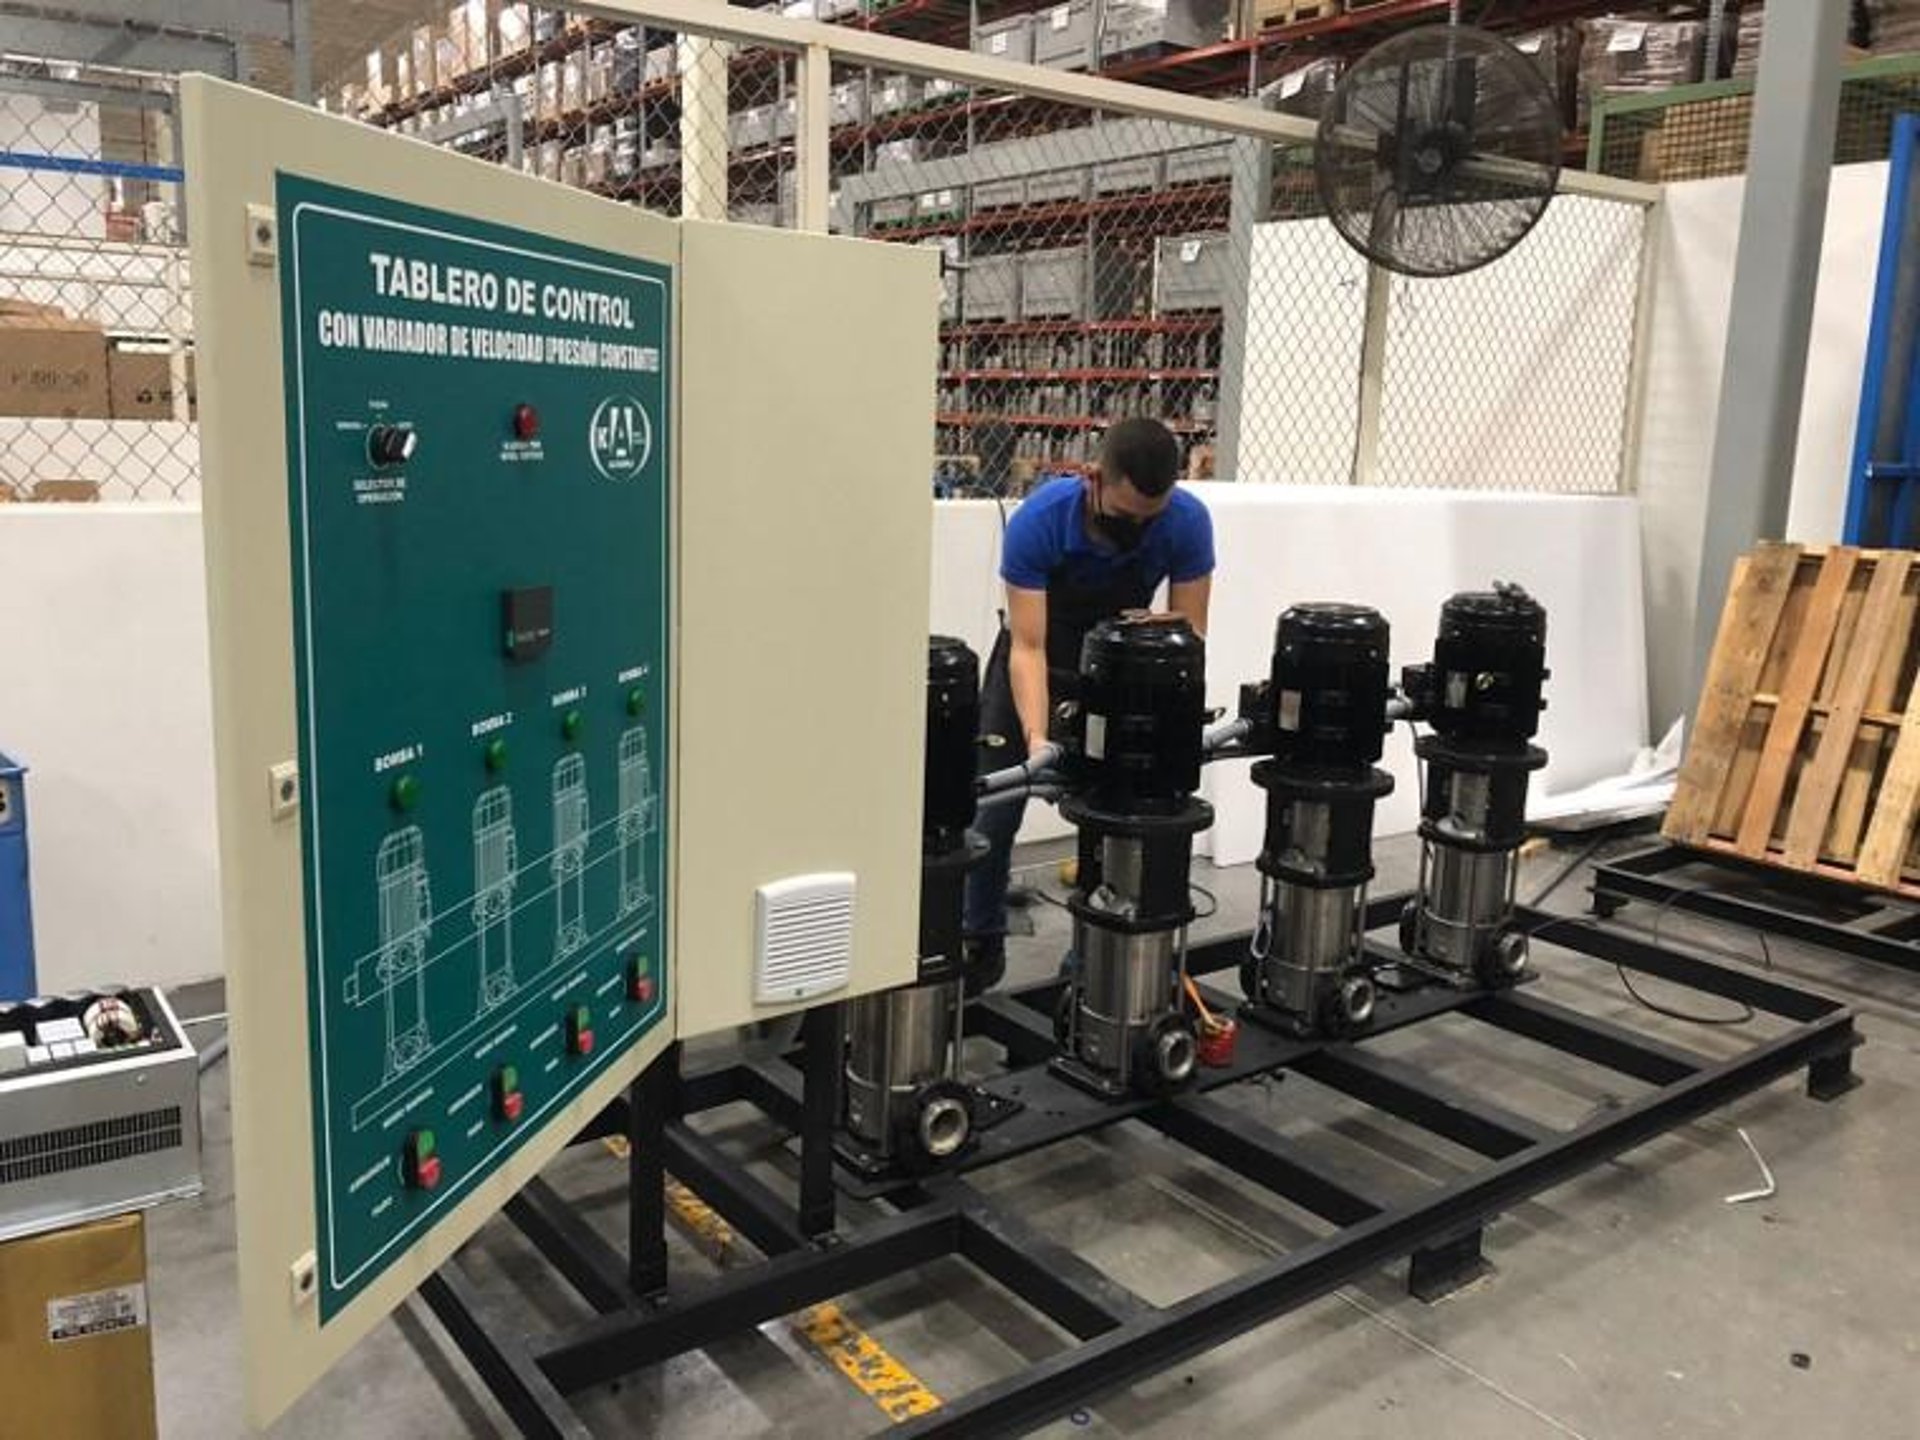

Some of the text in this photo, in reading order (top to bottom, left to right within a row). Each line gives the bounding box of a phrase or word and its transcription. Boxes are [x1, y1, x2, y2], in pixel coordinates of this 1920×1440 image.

[370, 253, 635, 330] TABLERO DE CONTROL
[318, 310, 360, 349] CON
[362, 314, 449, 356] VARIADOR
[451, 325, 469, 357] DE
[471, 328, 544, 363] VELOCIDAD
[471, 714, 504, 737] BOMBA
[374, 746, 415, 773] BOMBA
